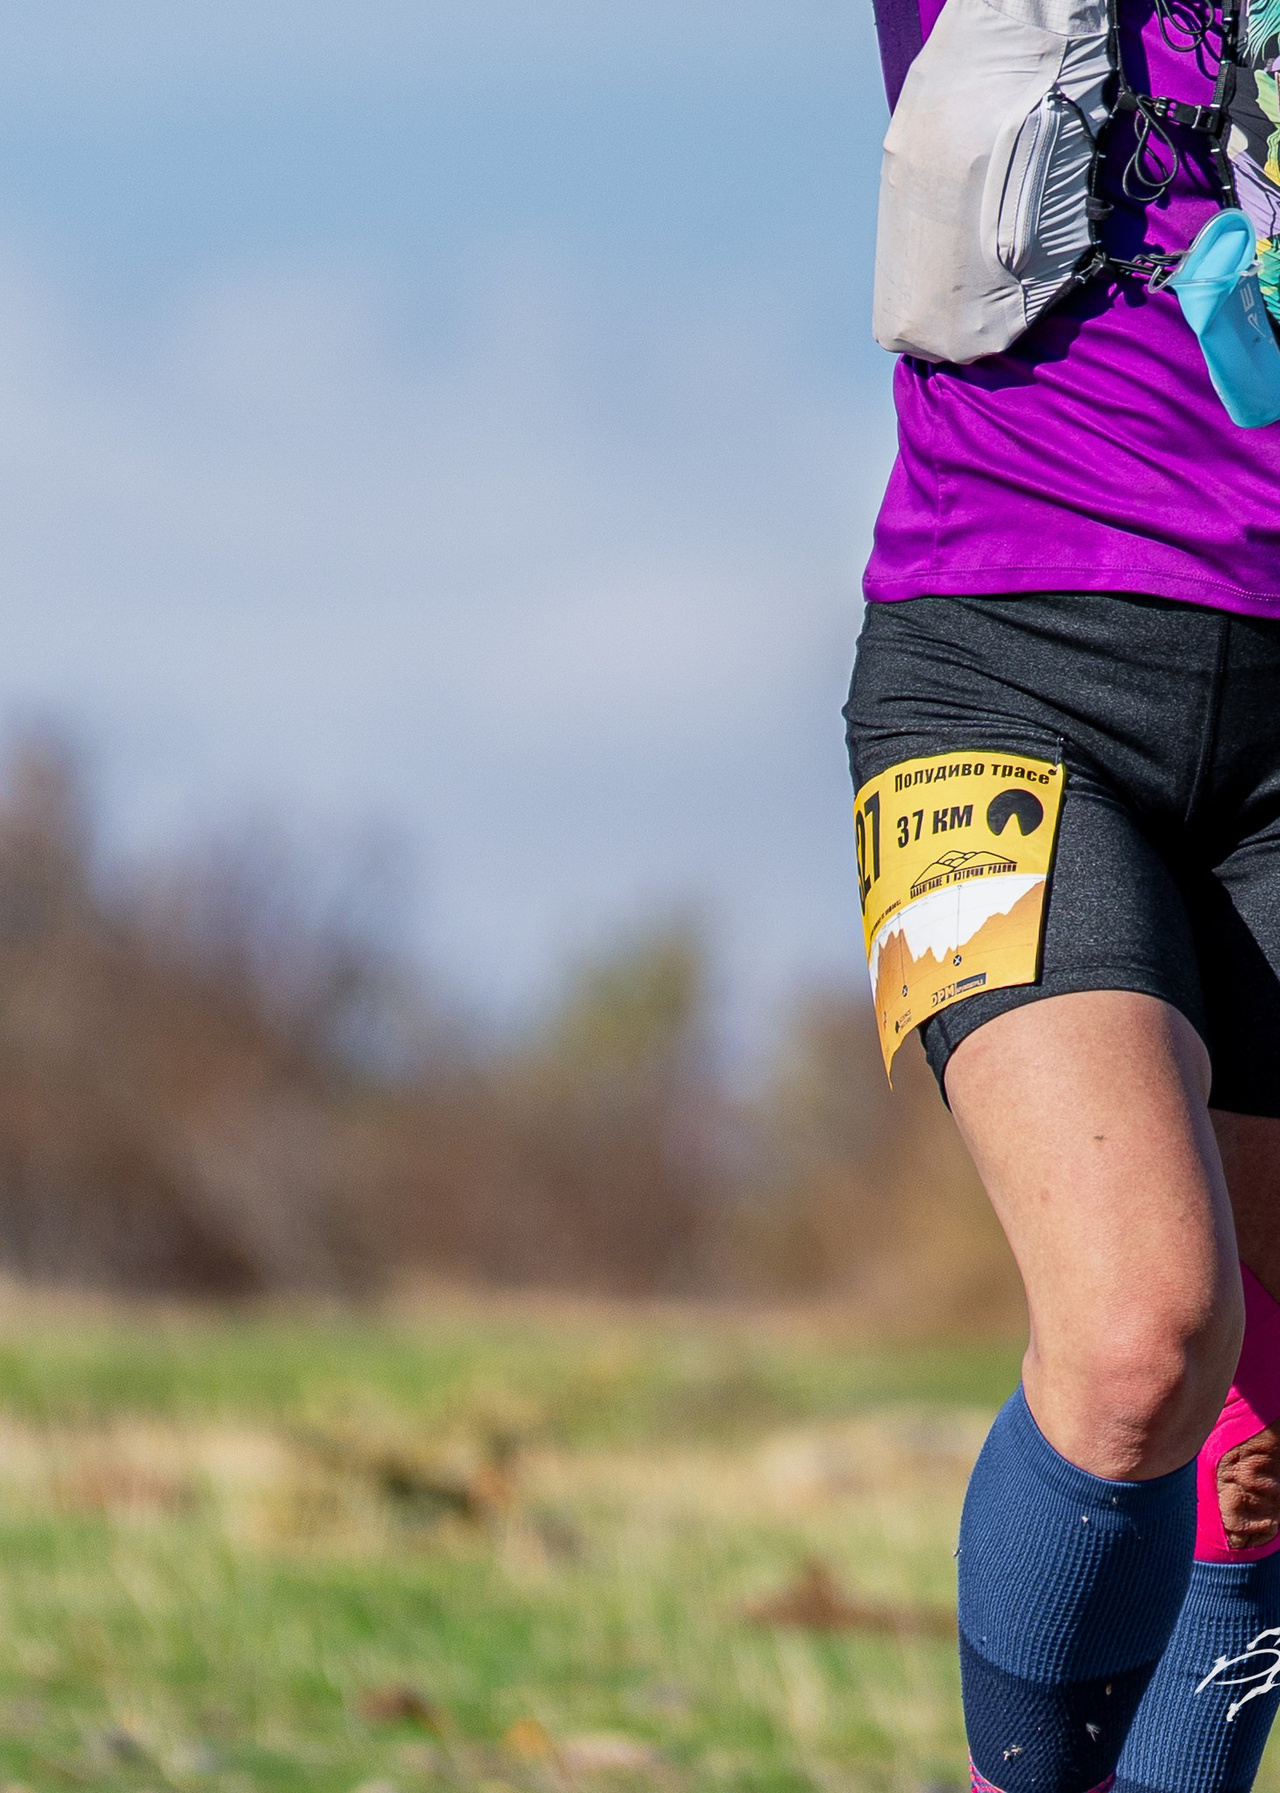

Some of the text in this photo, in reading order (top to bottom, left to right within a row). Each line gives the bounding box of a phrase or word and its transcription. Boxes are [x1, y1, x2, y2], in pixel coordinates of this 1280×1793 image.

[894, 763, 1050, 793] Полудиво трасе
[897, 809, 924, 849] 37
